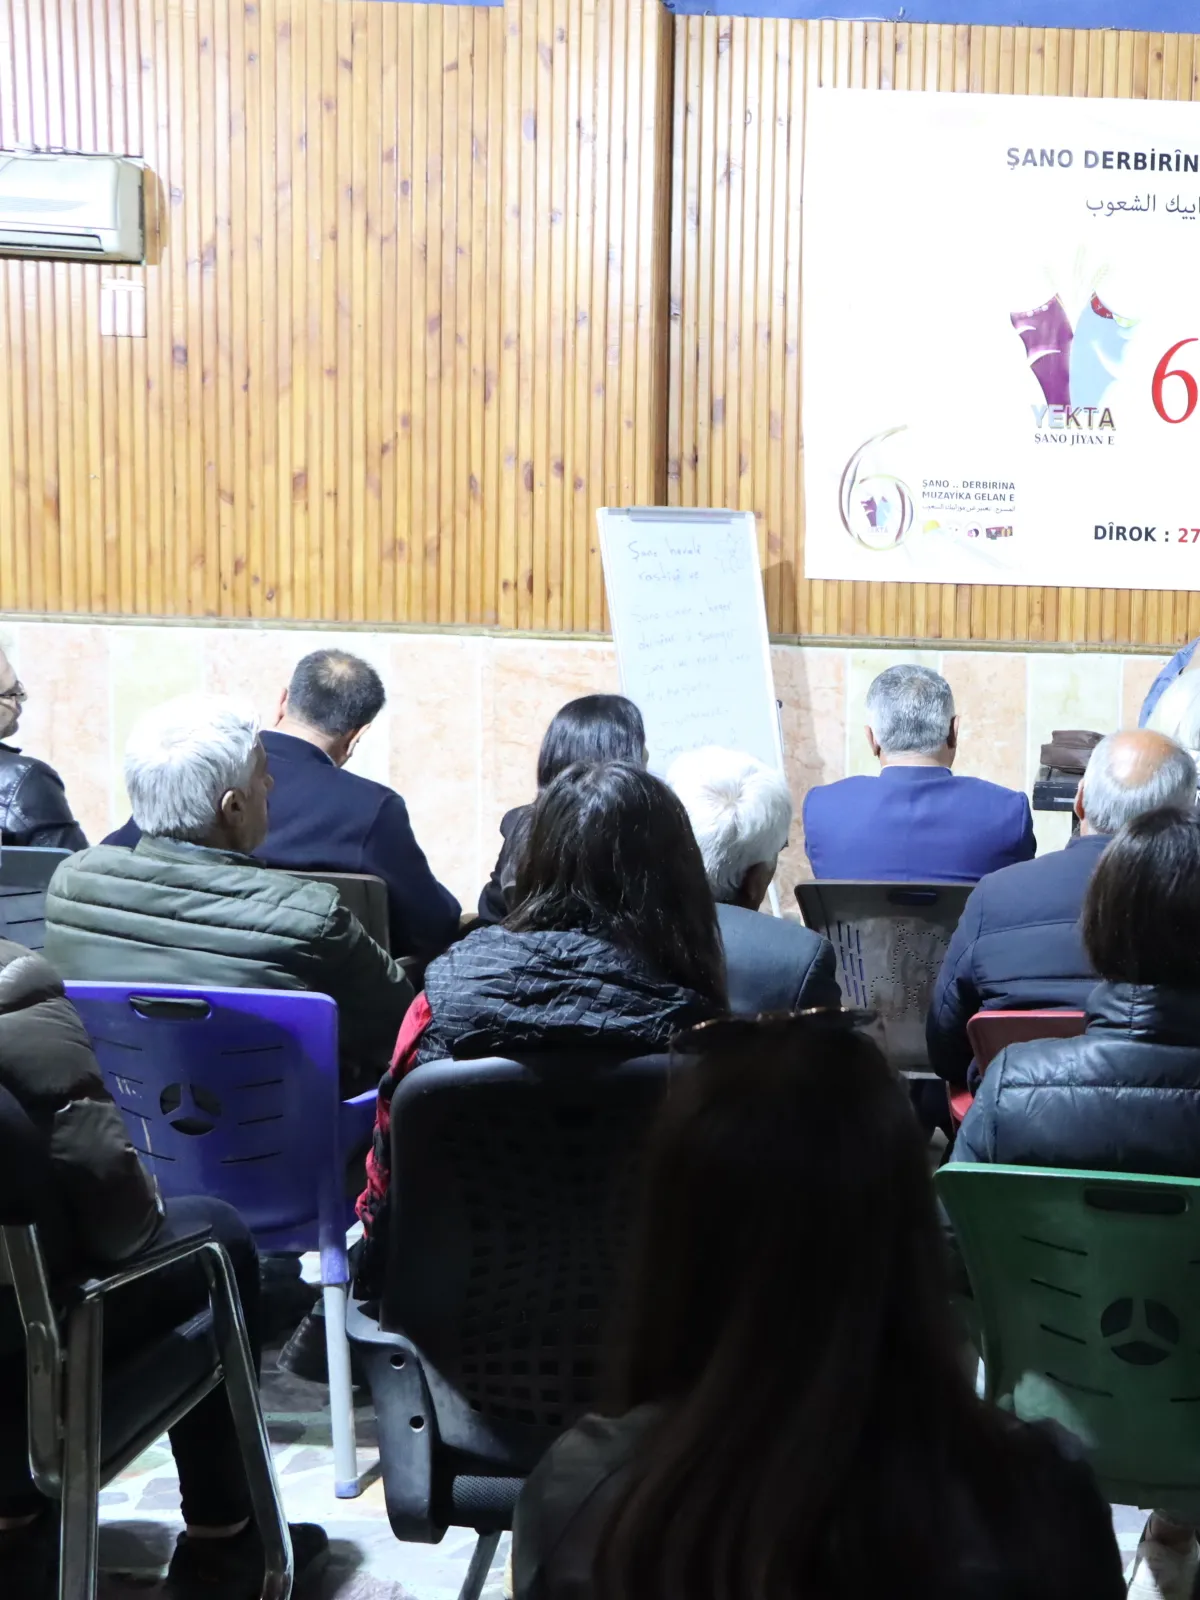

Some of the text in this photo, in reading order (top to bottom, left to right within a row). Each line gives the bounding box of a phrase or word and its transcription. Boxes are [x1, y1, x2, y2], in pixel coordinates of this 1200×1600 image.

[1007, 147, 1073, 171] ŞANO
[1086, 193, 1156, 217] الشعوب
[1151, 337, 1199, 424] 6
[1030, 403, 1116, 431] YEKTA
[1034, 433, 1067, 445] ŞANO
[1108, 436, 1115, 445] E
[922, 479, 949, 489] ŞANO
[975, 492, 1006, 501] GELAN
[1009, 493, 1015, 501] E
[1094, 521, 1157, 542] DÎROK
[1177, 528, 1200, 544] 27
